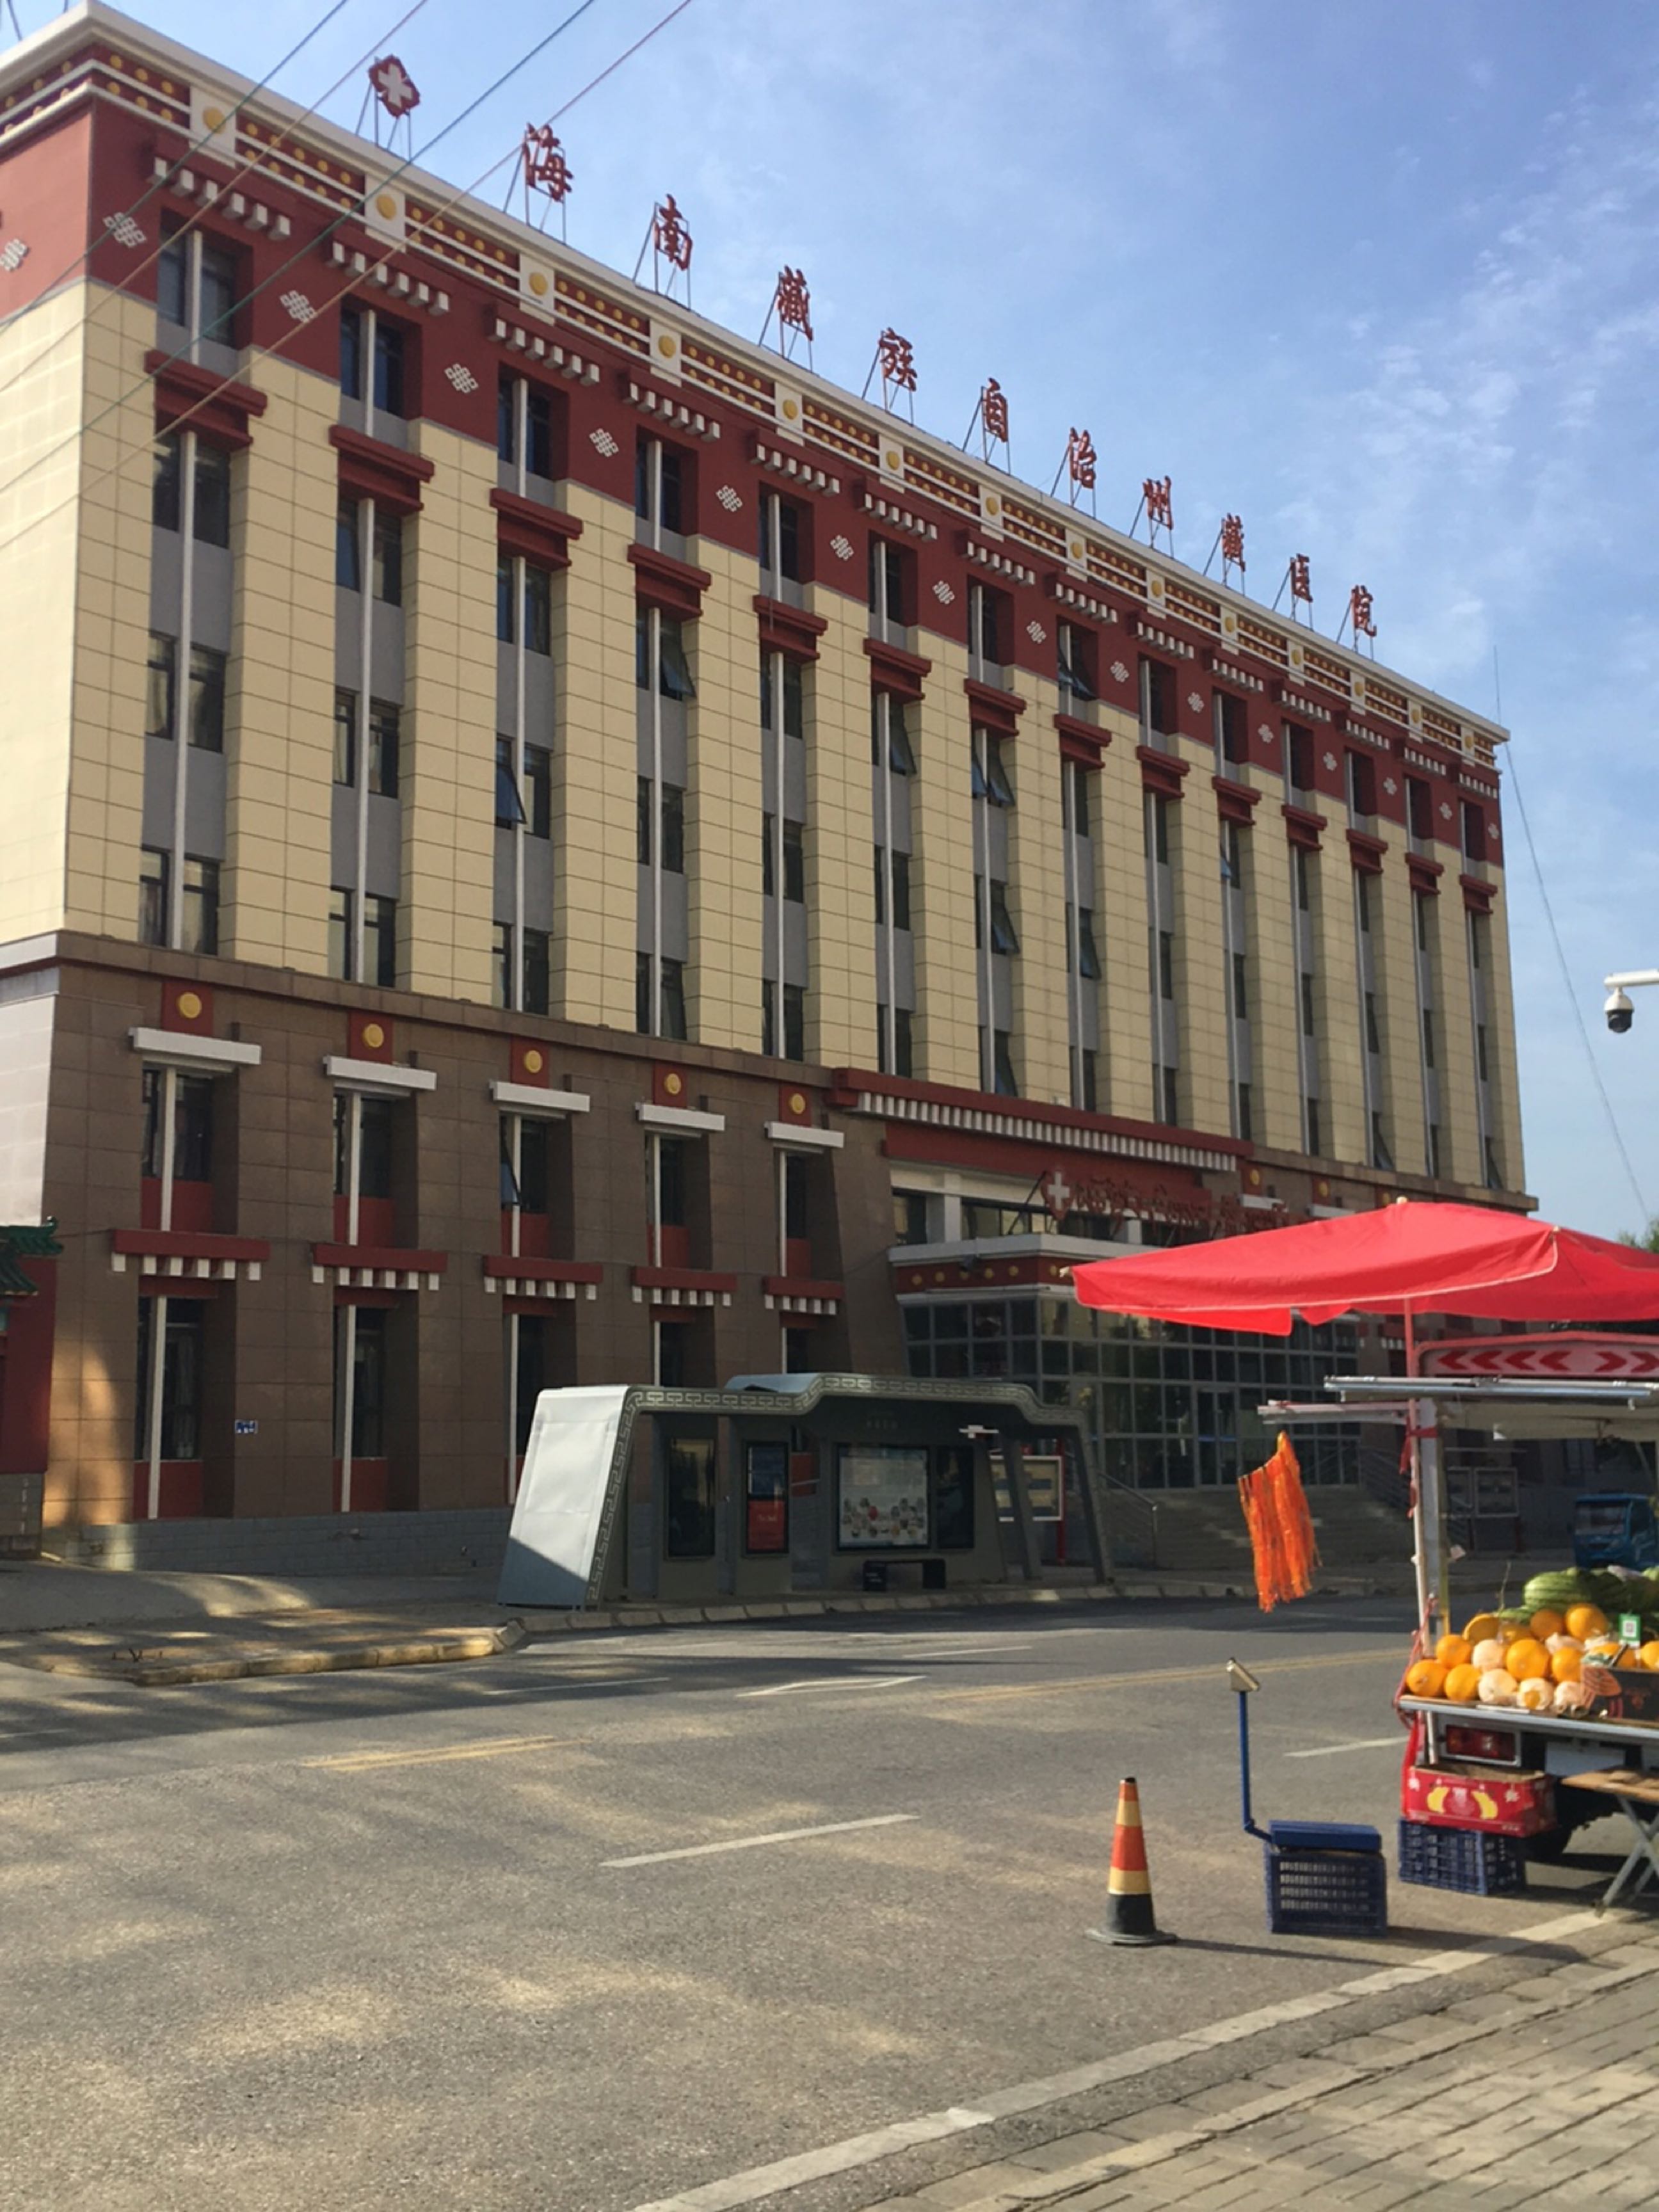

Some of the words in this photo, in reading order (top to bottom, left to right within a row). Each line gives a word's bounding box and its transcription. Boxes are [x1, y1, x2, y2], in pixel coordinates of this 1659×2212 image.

[522, 122, 1377, 637] 海南藏族自治州藏医院
